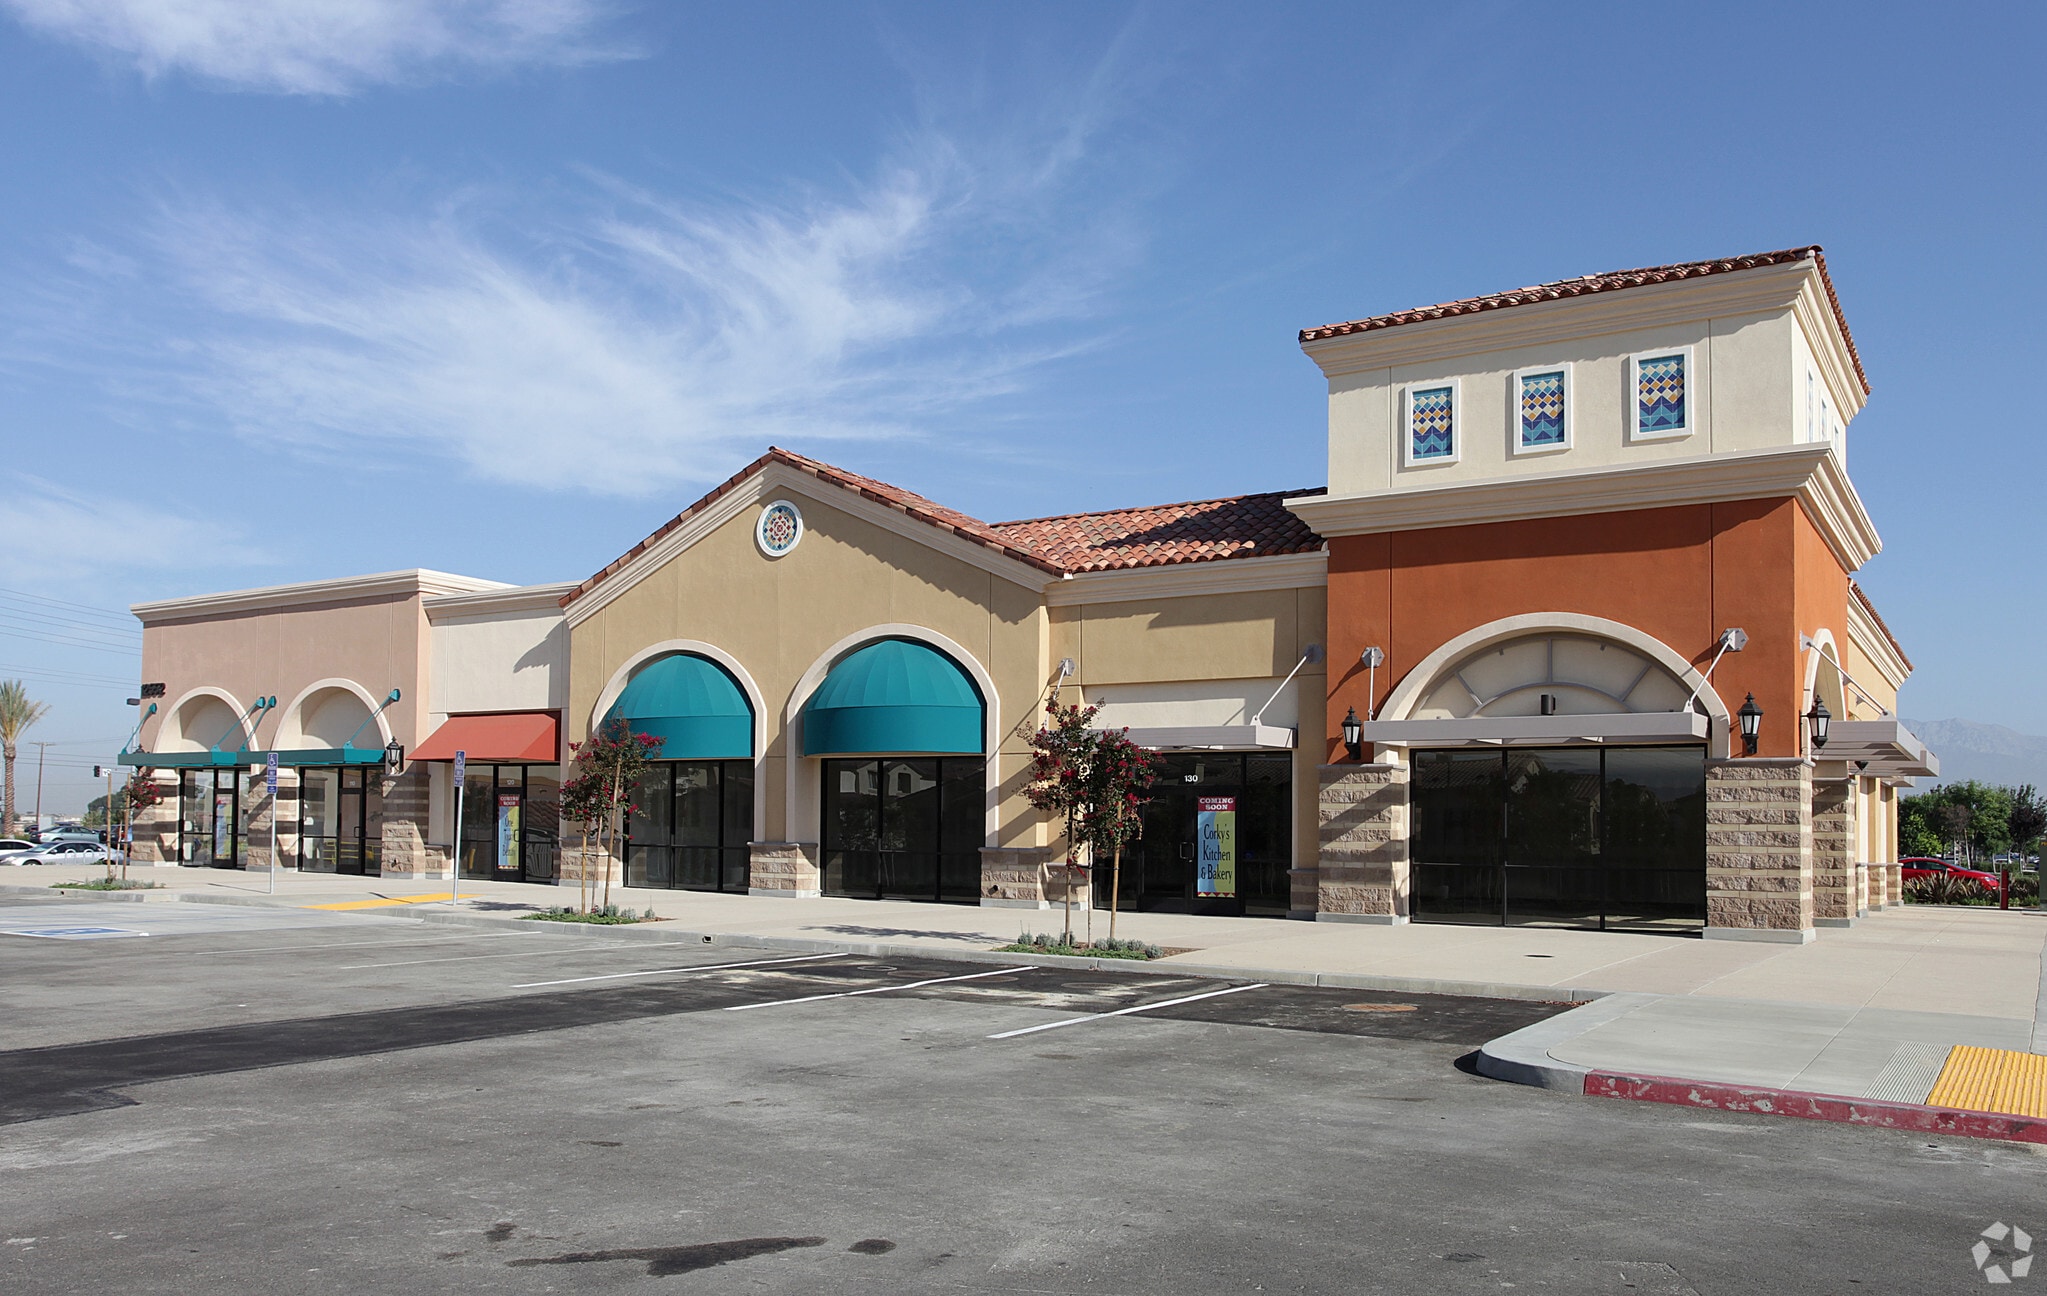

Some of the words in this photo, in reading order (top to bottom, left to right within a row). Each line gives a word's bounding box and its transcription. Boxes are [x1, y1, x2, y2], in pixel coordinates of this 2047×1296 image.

[1203, 823, 1230, 844] Corky's
[1202, 840, 1231, 861] Kitchen
[1201, 866, 1206, 880] &
[1207, 864, 1232, 884] Bakery
